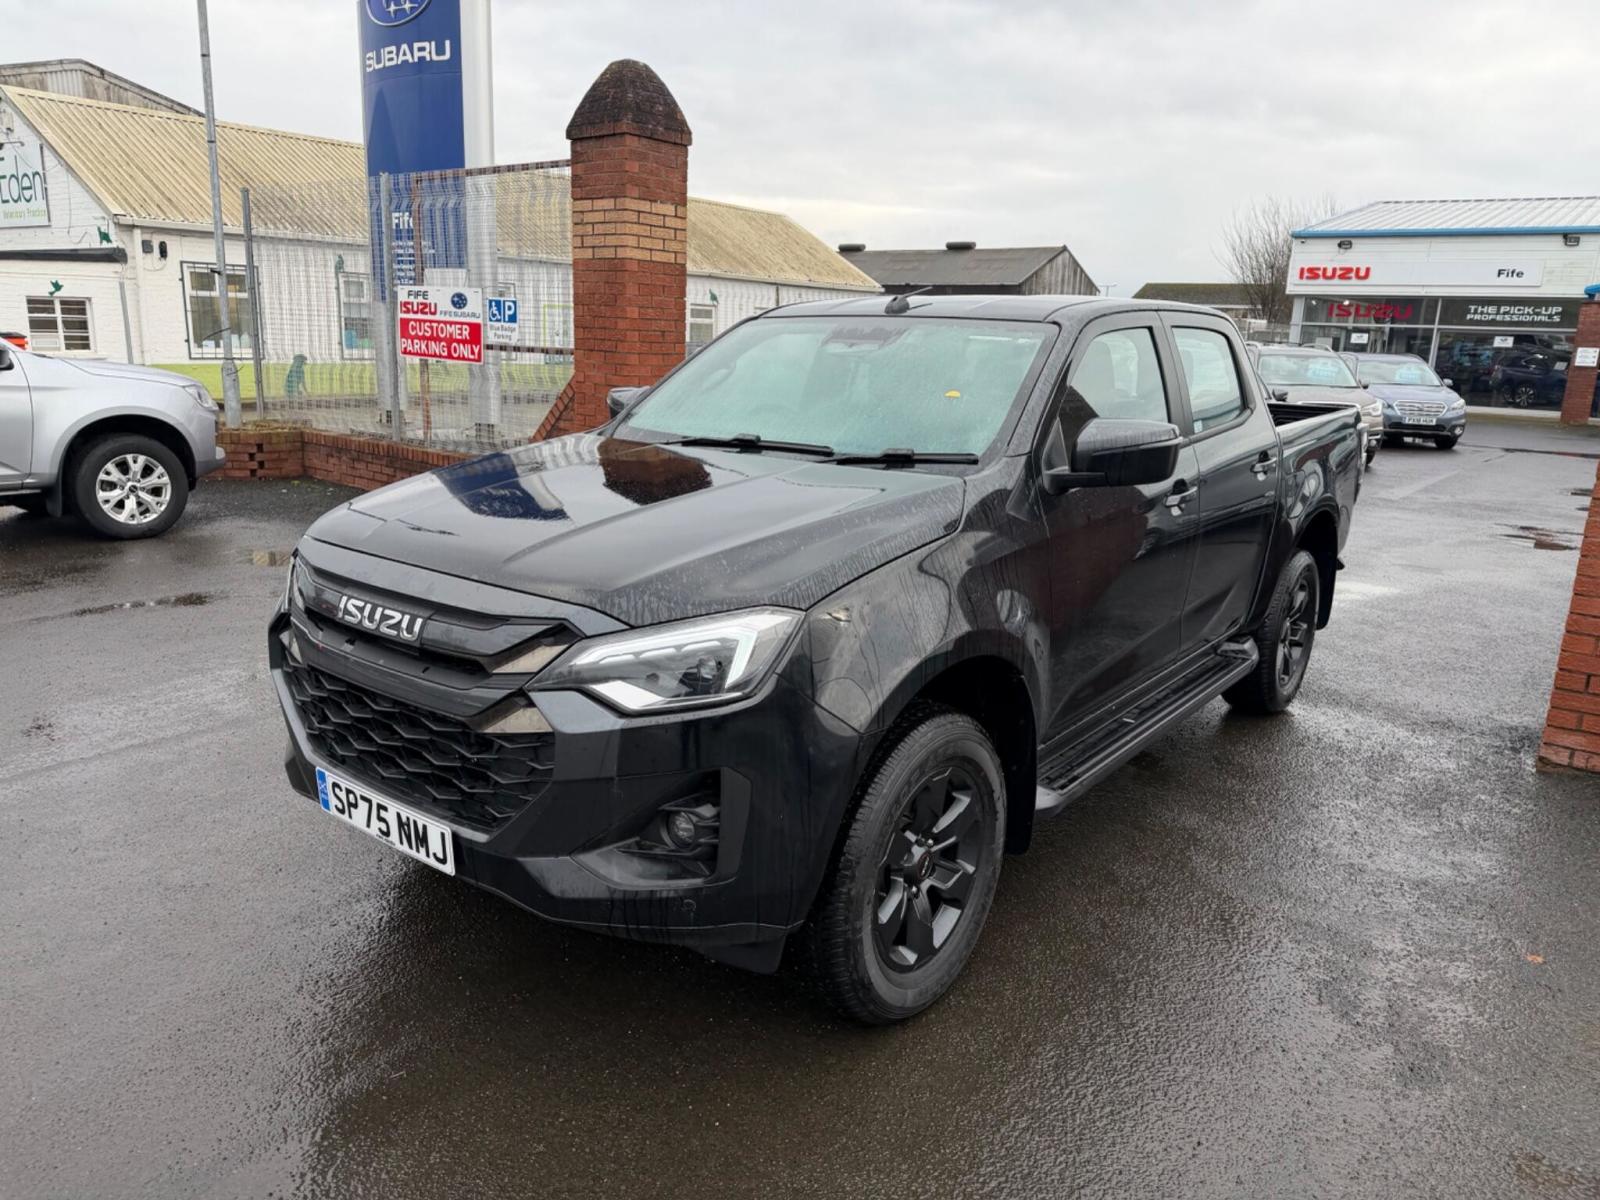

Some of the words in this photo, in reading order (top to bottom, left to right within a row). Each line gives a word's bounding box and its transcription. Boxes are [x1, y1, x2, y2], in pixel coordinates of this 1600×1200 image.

[366, 39, 450, 72] SUBARU
[0, 154, 45, 204] Eden
[1298, 266, 1371, 281] ISUZU
[1497, 268, 1525, 279] Fife
[407, 289, 429, 300] FIFE
[400, 300, 438, 316] ISUZU
[504, 301, 515, 322] P
[1328, 302, 1413, 319] ISUZU
[1468, 305, 1498, 314] THE
[1499, 306, 1563, 315] PICK-UP
[1466, 313, 1561, 322] PROFESSIONALS
[408, 321, 470, 340] CUSTOMER
[401, 338, 448, 357] PARKING
[450, 342, 480, 360] ONLY
[337, 594, 423, 641] ISUZU
[331, 781, 391, 838] SP75
[396, 811, 448, 866] NMJ
